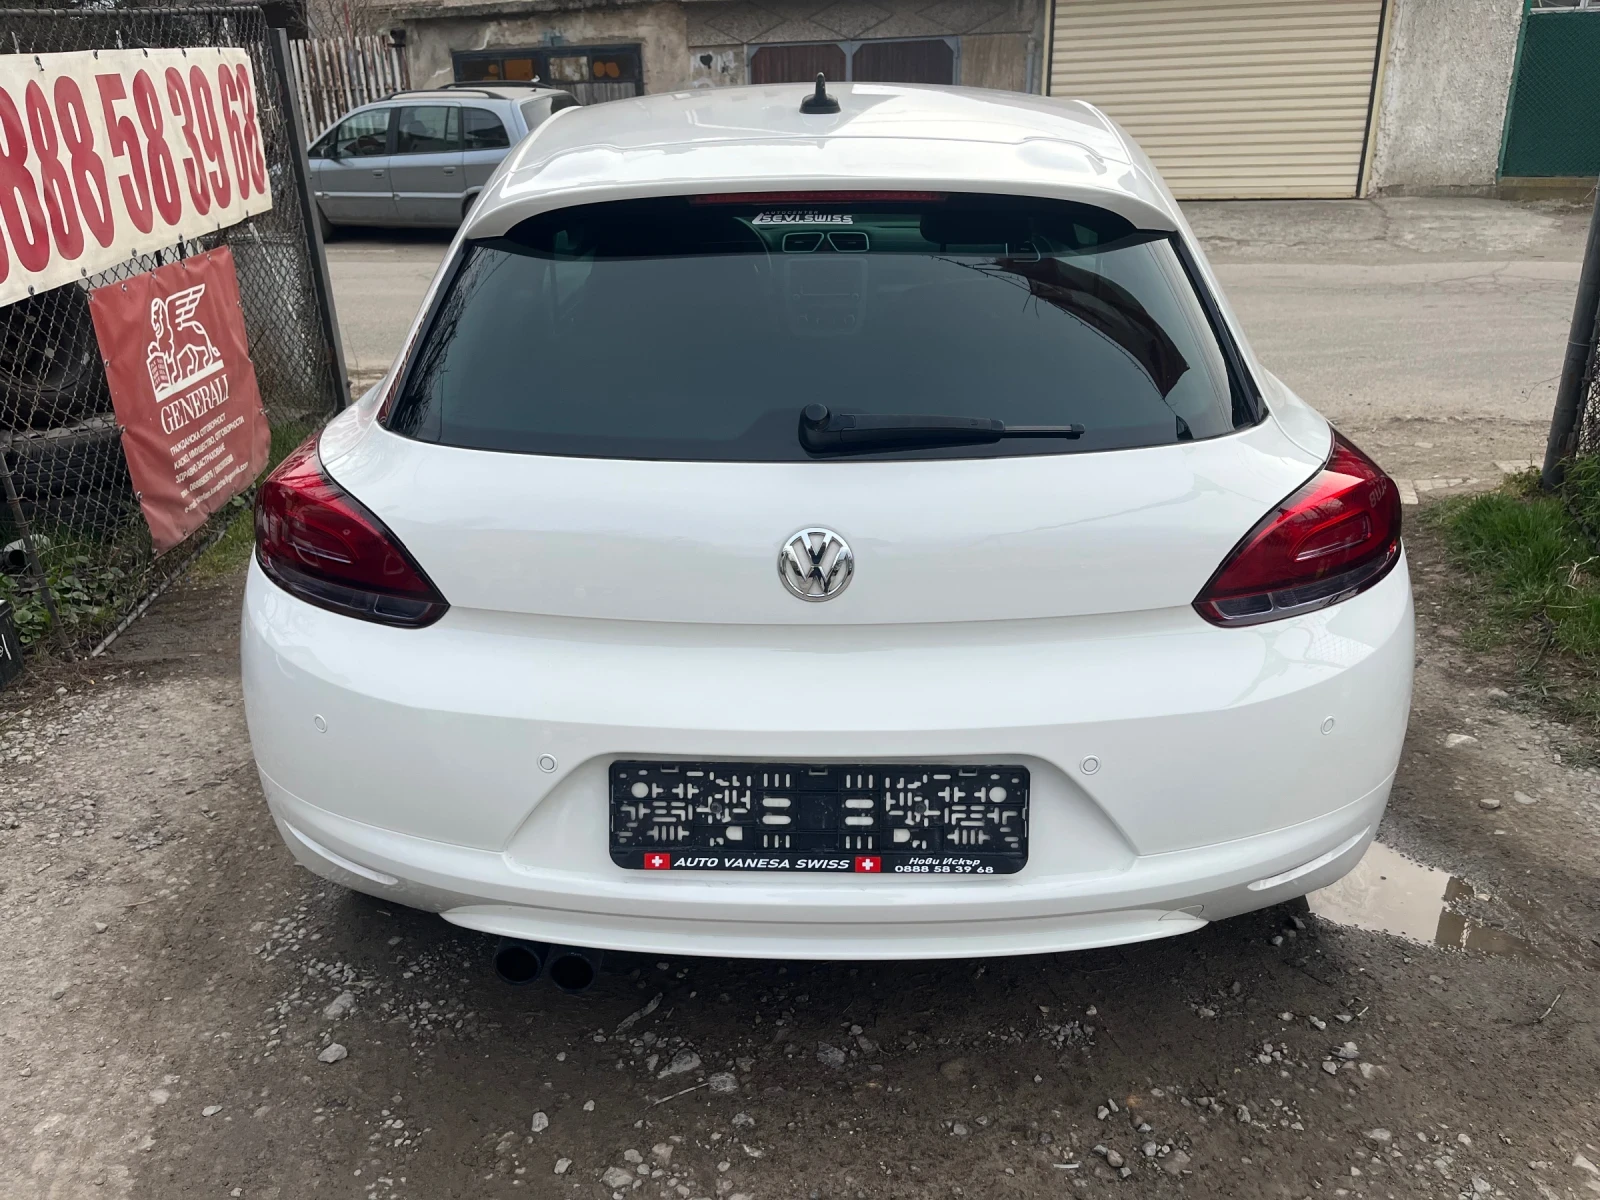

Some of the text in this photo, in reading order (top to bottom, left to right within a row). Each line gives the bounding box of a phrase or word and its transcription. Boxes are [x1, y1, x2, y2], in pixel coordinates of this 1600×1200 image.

[0, 63, 265, 286] 888 58 39 68
[804, 214, 853, 222] SWISS
[160, 373, 230, 435] GENERALI
[170, 412, 226, 456] ГРАЖДАНСКА ОТГОВОРНОСТ
[189, 435, 216, 460] ИМУЩЕСТВО,
[215, 415, 245, 441] ОТГОВОРНОСТИ
[175, 464, 199, 484] ЗДРАВНО
[674, 857, 851, 869] AUTO VANESA SWISS
[894, 865, 929, 873] 0888
[954, 866, 972, 874] 39
[976, 866, 994, 874] 68
[909, 857, 981, 867] Нови Искър
